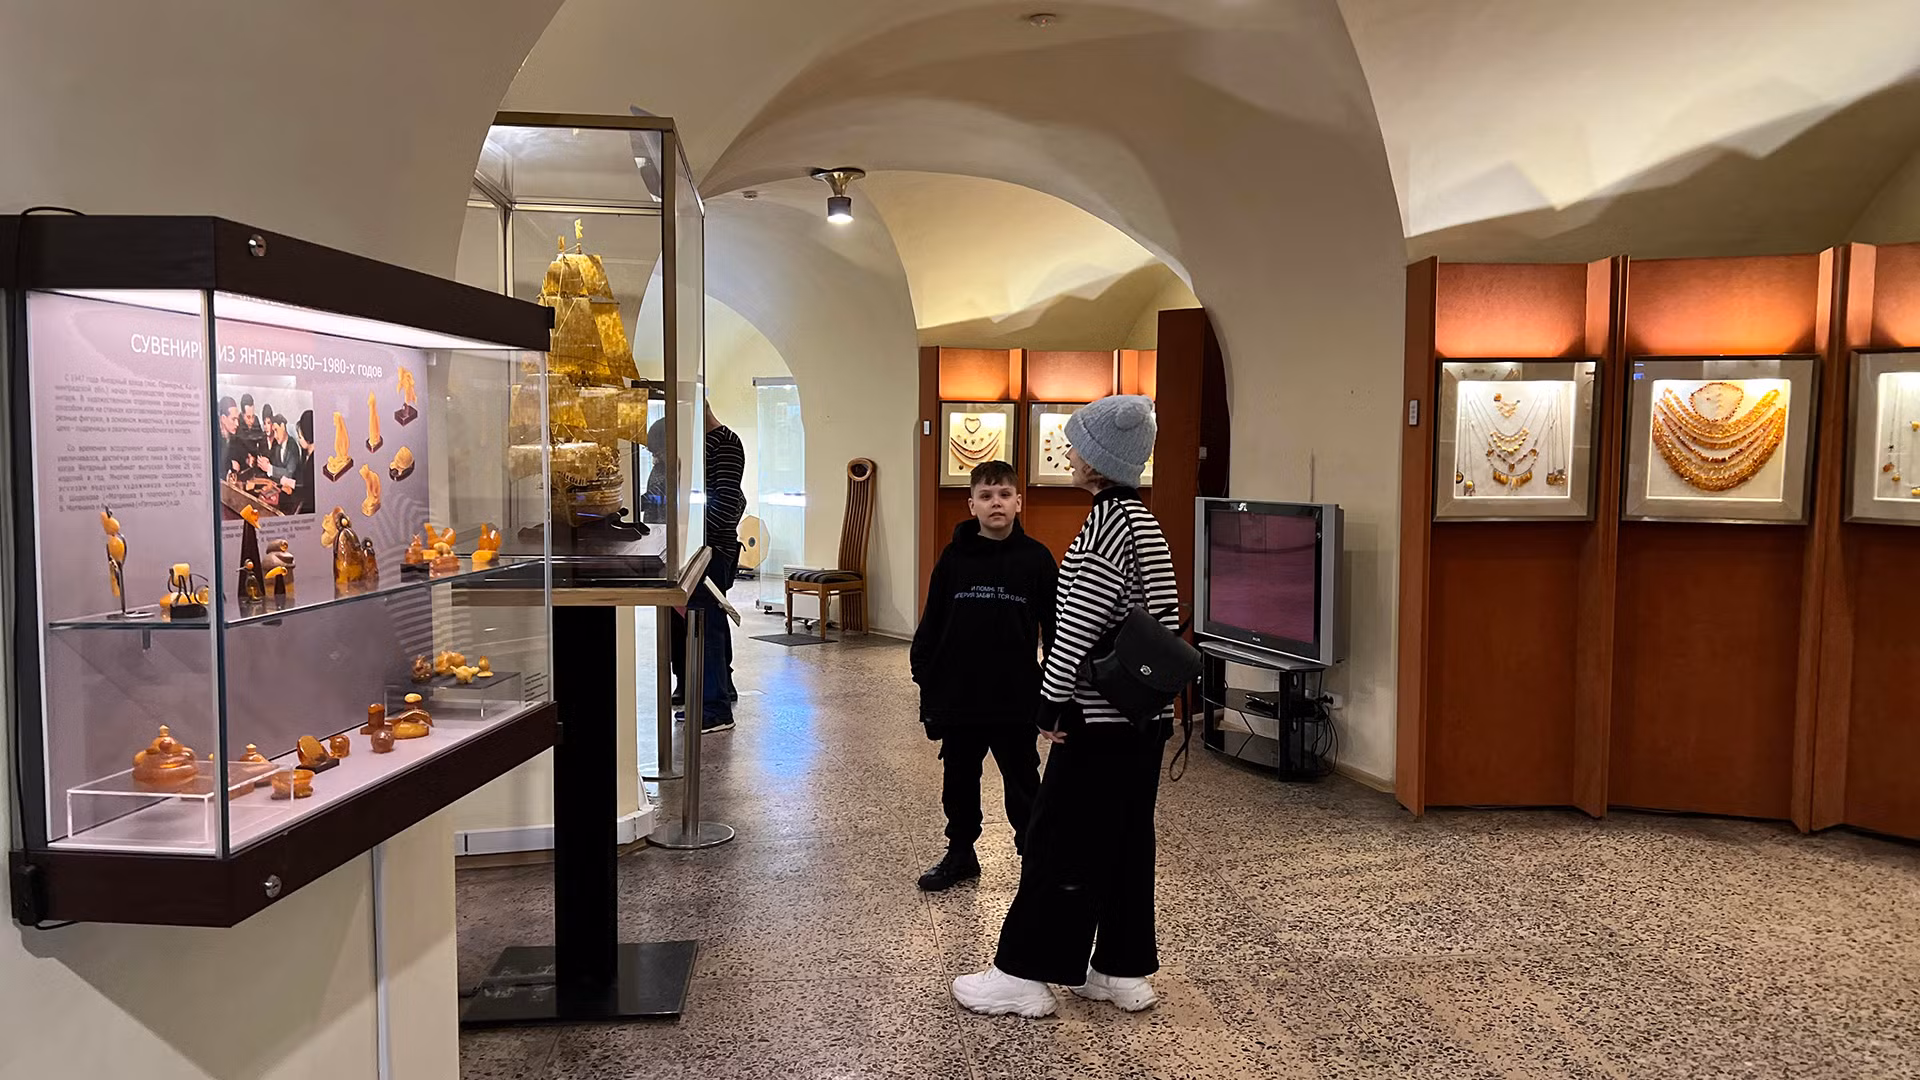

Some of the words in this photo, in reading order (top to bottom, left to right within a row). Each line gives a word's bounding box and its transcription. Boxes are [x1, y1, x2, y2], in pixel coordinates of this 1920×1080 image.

[218, 345, 236, 363] ИЗ
[239, 347, 286, 368] ЯНТАРЯ
[357, 364, 383, 378] годов
